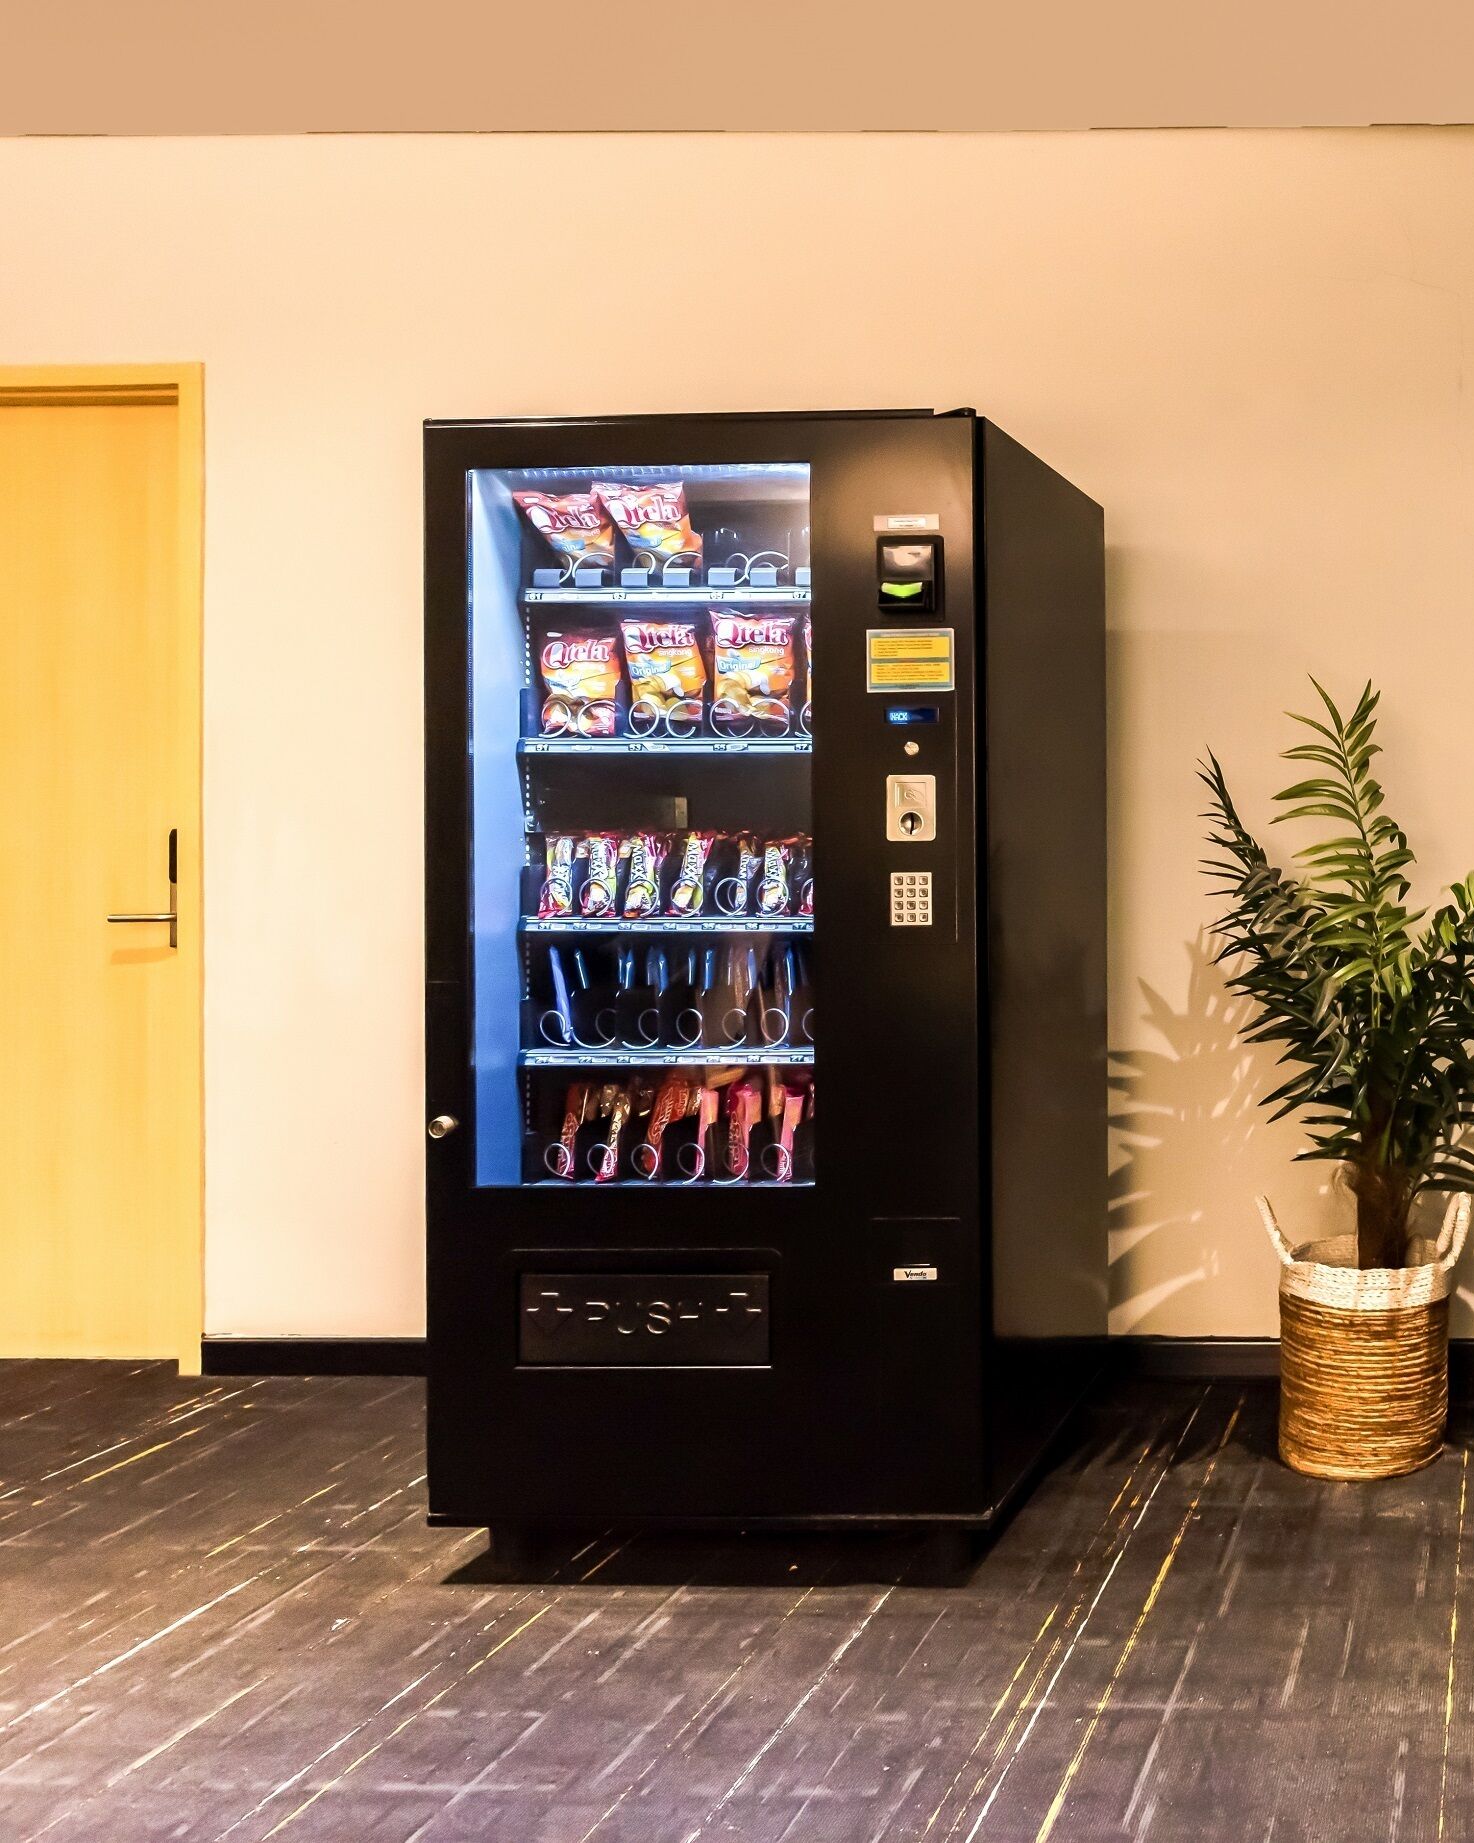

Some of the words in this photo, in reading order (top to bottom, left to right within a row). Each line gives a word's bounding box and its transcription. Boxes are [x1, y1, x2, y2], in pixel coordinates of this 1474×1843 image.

[605, 494, 681, 529] Qtela
[623, 624, 695, 653] Qtela
[715, 619, 789, 649] Qtela
[543, 639, 609, 669] Qtela
